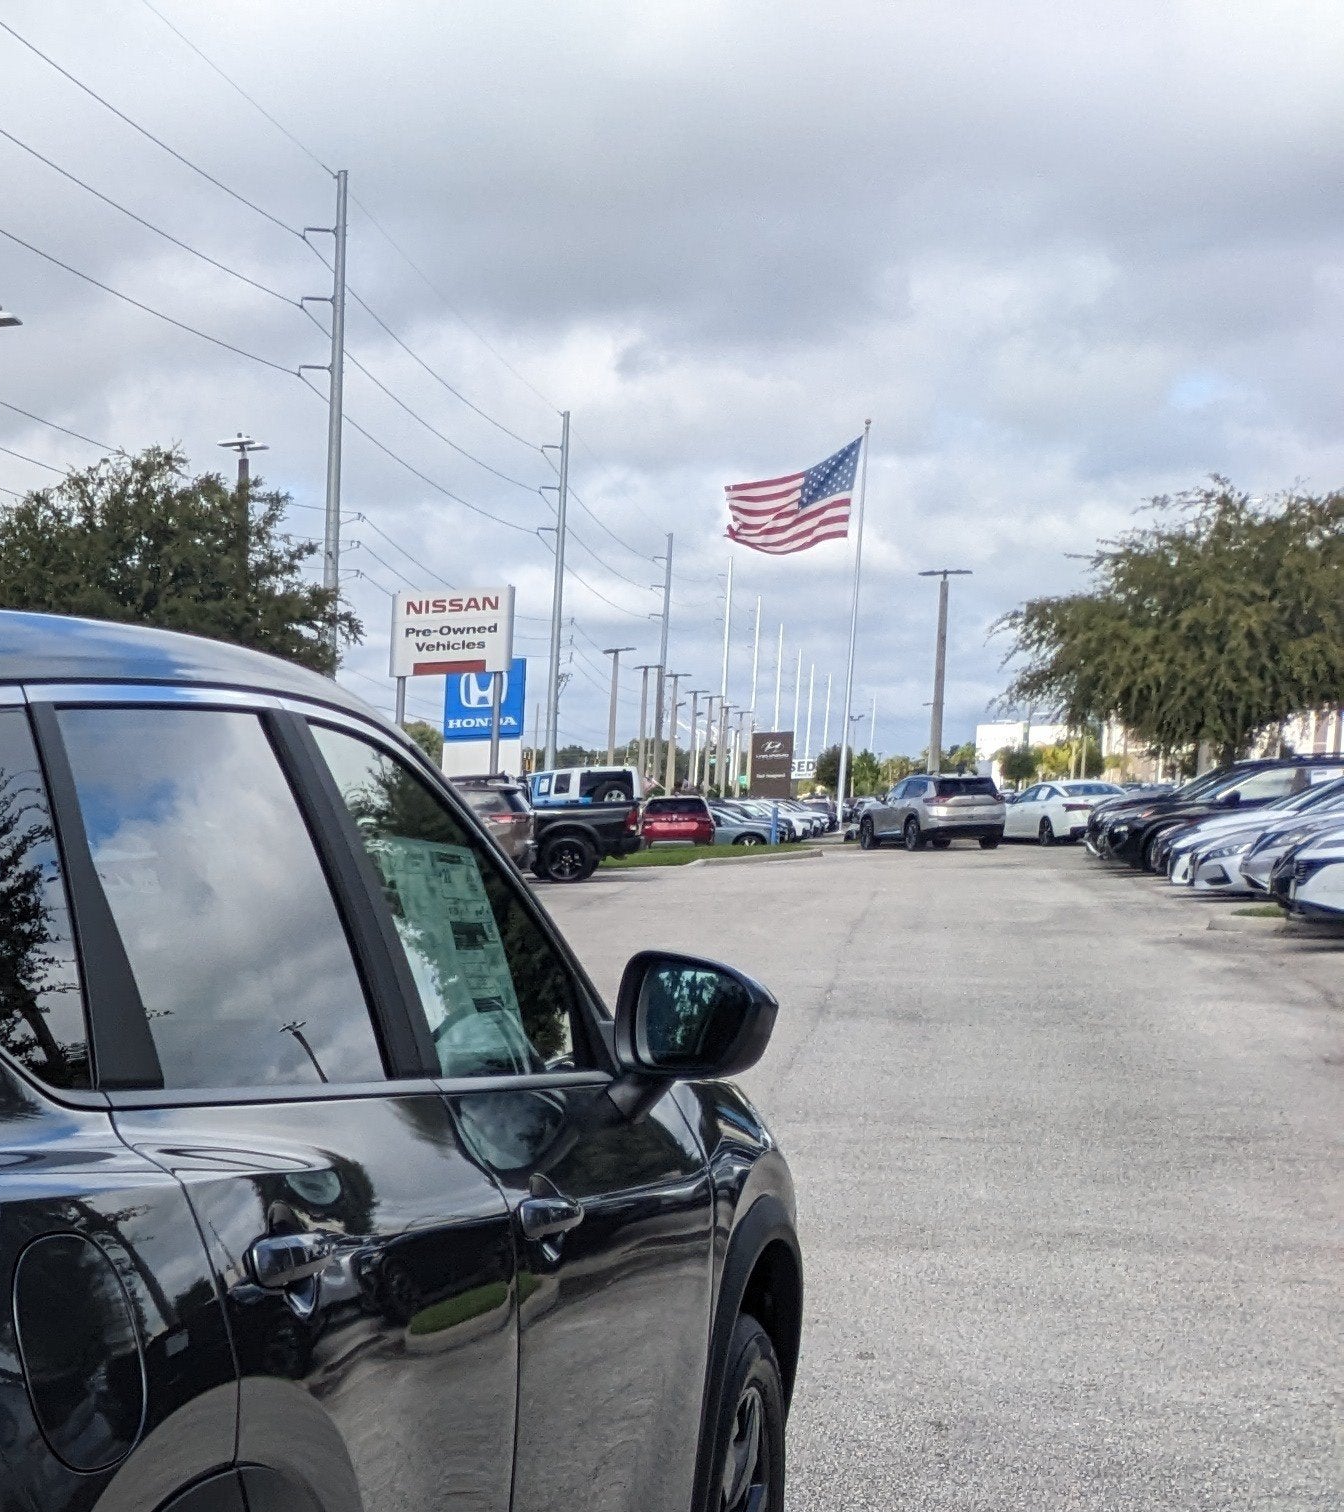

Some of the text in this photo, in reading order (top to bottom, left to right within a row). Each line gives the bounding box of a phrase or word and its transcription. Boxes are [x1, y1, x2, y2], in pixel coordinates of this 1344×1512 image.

[406, 596, 499, 615] NISSAN
[405, 622, 498, 638] Pre-Owned
[415, 640, 486, 652] Vehicles
